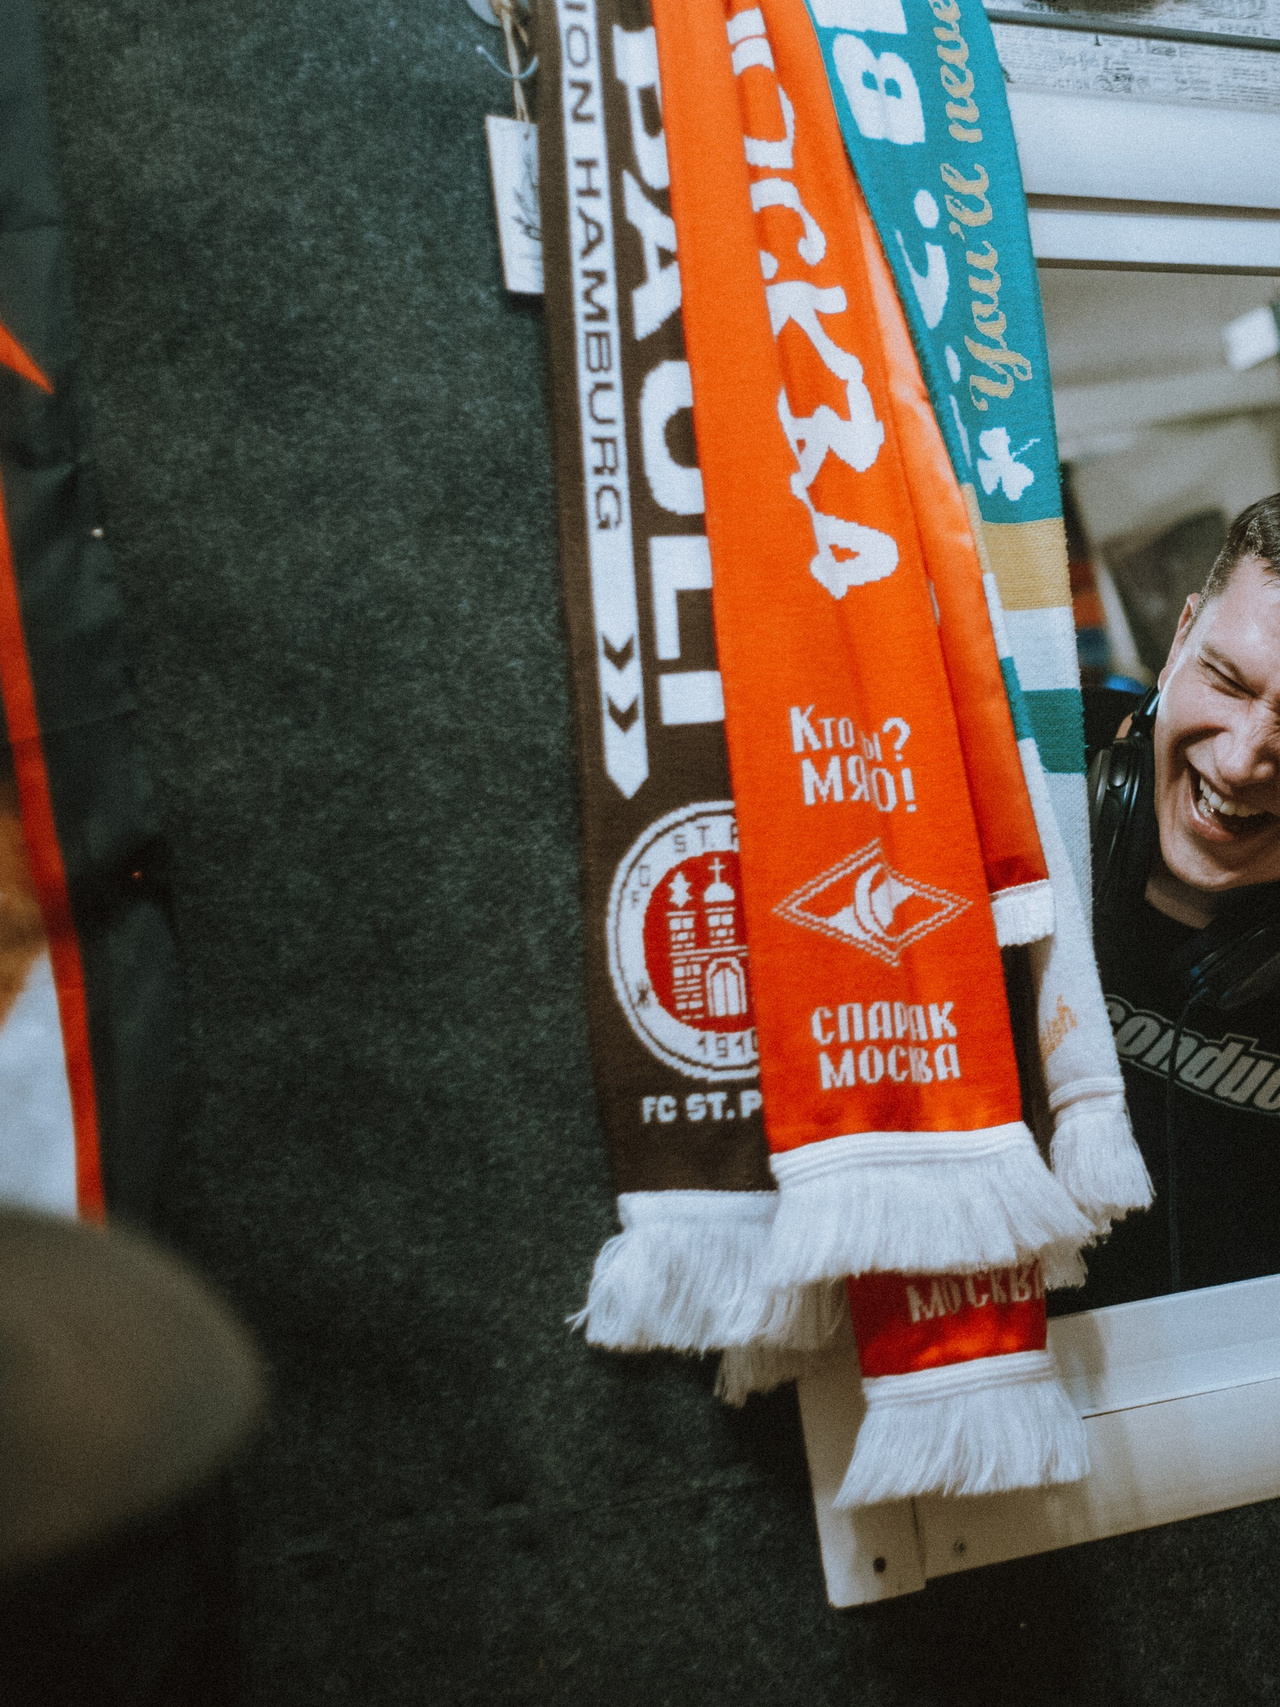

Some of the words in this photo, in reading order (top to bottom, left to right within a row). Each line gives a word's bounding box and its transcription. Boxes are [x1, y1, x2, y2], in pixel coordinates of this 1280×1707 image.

[574, 158, 623, 531] HAMBURG
[940, 162, 1034, 413] You'll
[641, 1094, 678, 1124] FC
[685, 1091, 736, 1122] ST.
